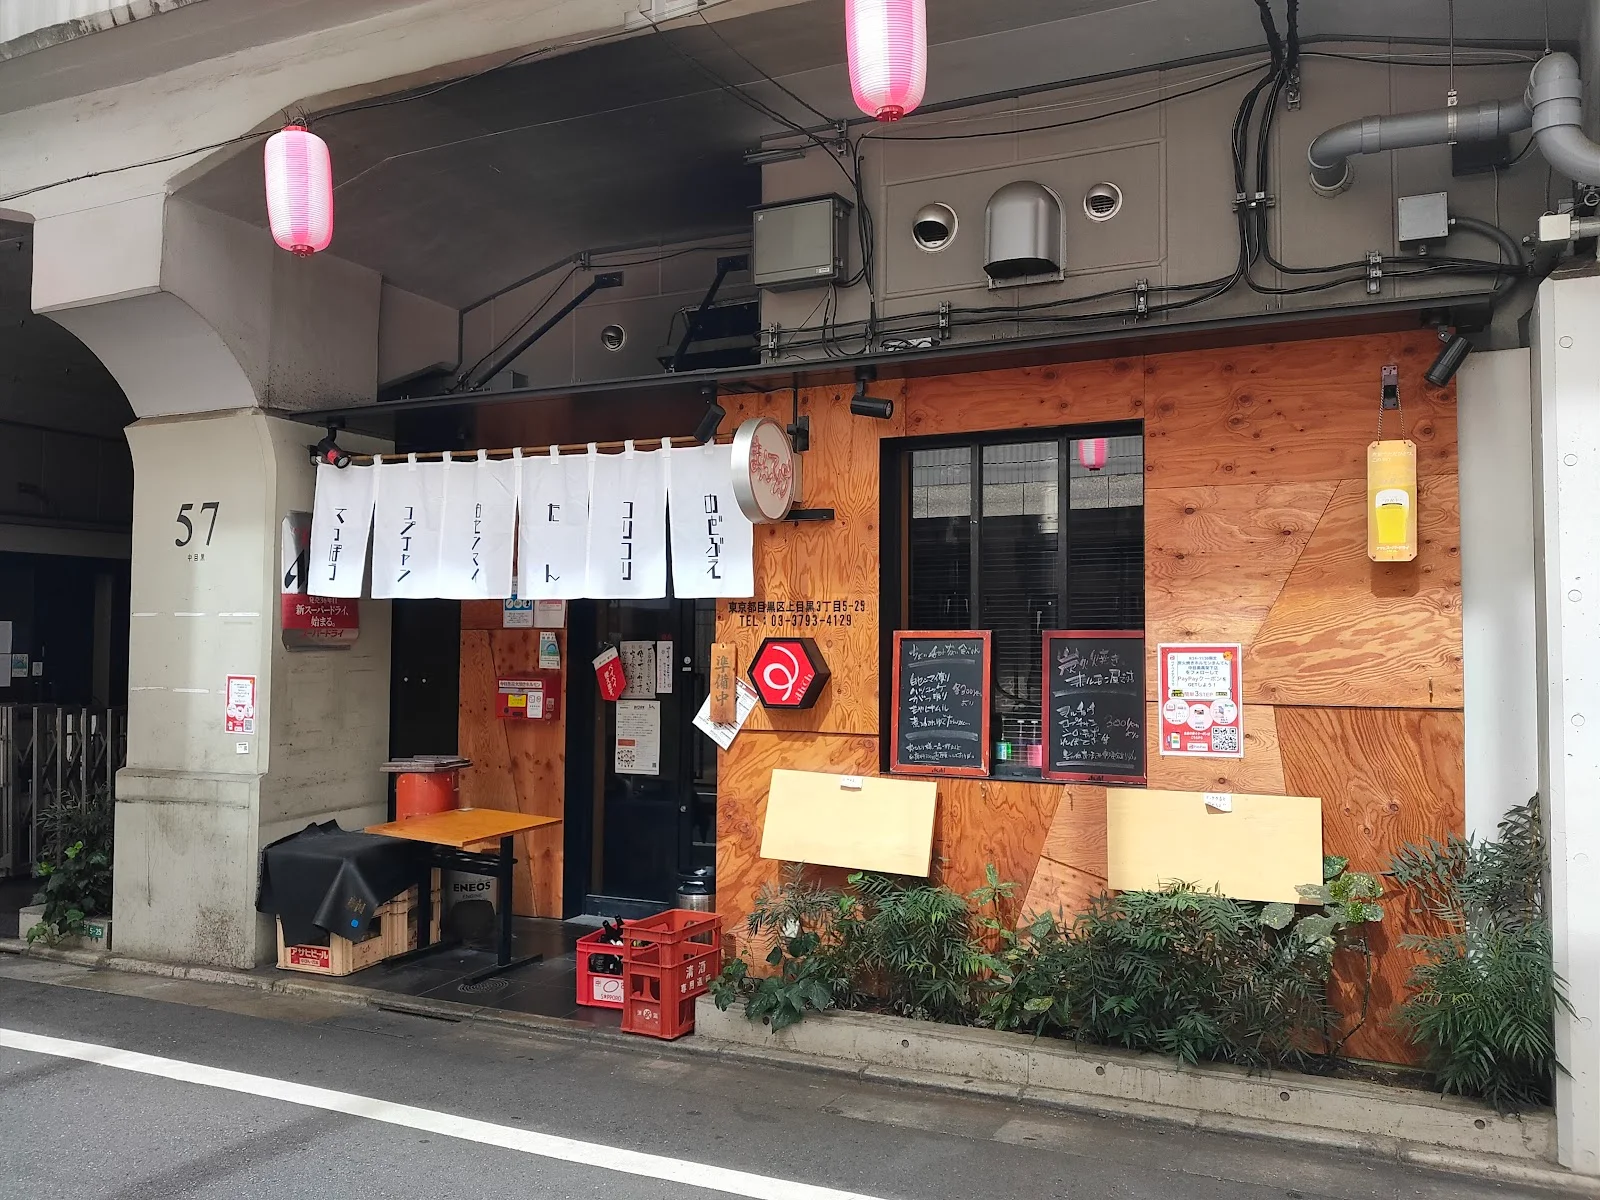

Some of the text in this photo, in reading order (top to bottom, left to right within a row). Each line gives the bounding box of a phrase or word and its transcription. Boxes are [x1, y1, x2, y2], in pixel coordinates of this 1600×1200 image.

[175, 501, 220, 547] 57
[397, 506, 416, 583] コプチャン
[545, 503, 561, 583] たん
[621, 501, 634, 581] コリコリ
[187, 553, 205, 562] 中目黒
[311, 616, 336, 627] 始まる。
[714, 655, 731, 707] 準備中
[453, 881, 490, 892] ENEOS
[90, 928, 102, 936] 5-25
[291, 947, 329, 960] アサヒビール
